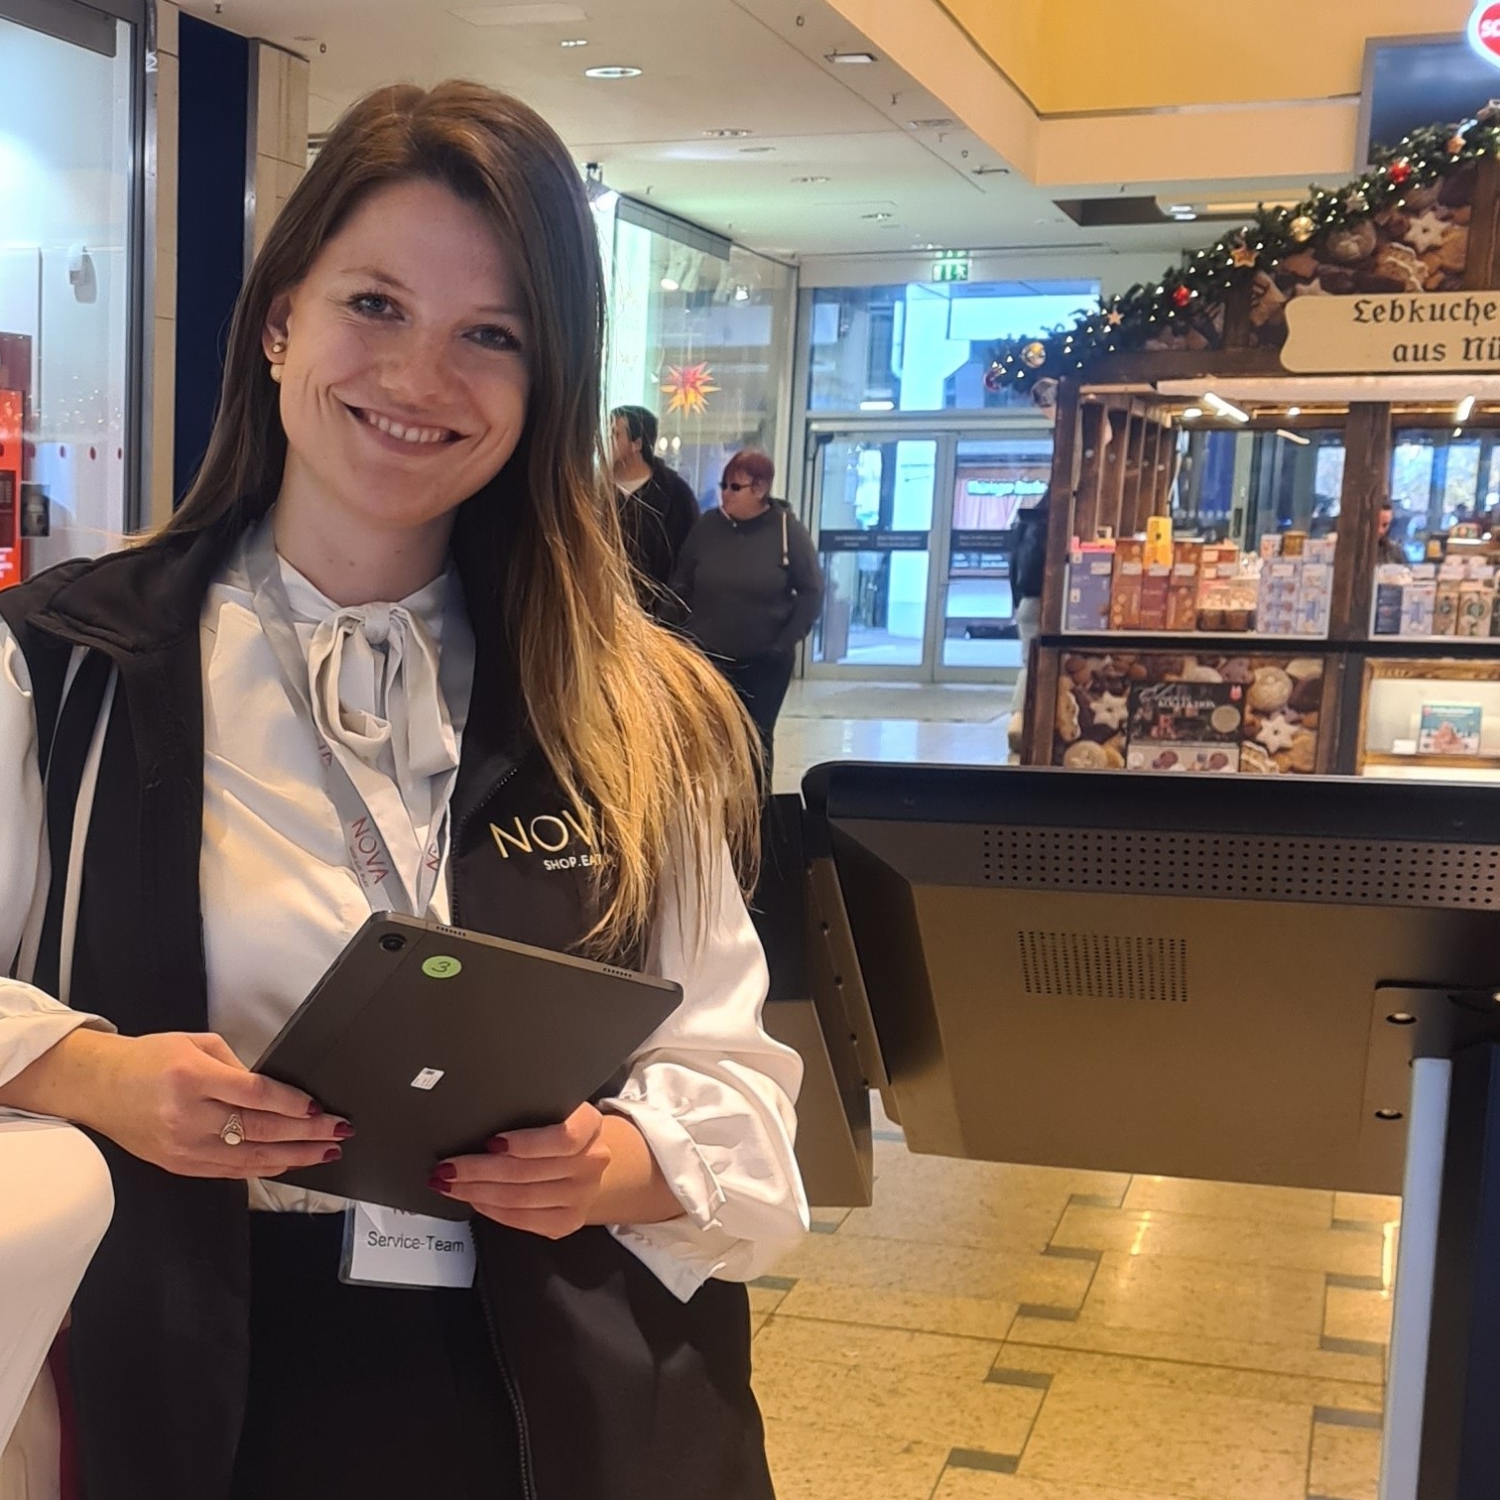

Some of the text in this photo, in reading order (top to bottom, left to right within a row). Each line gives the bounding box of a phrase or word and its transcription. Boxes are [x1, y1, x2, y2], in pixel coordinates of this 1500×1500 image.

[1353, 296, 1500, 327] Lebkuche
[1392, 336, 1500, 363] aus Nü
[488, 809, 600, 859] NOV
[351, 816, 390, 886] NOVA
[431, 961, 452, 973] 3
[367, 1230, 465, 1253] Service-Team
